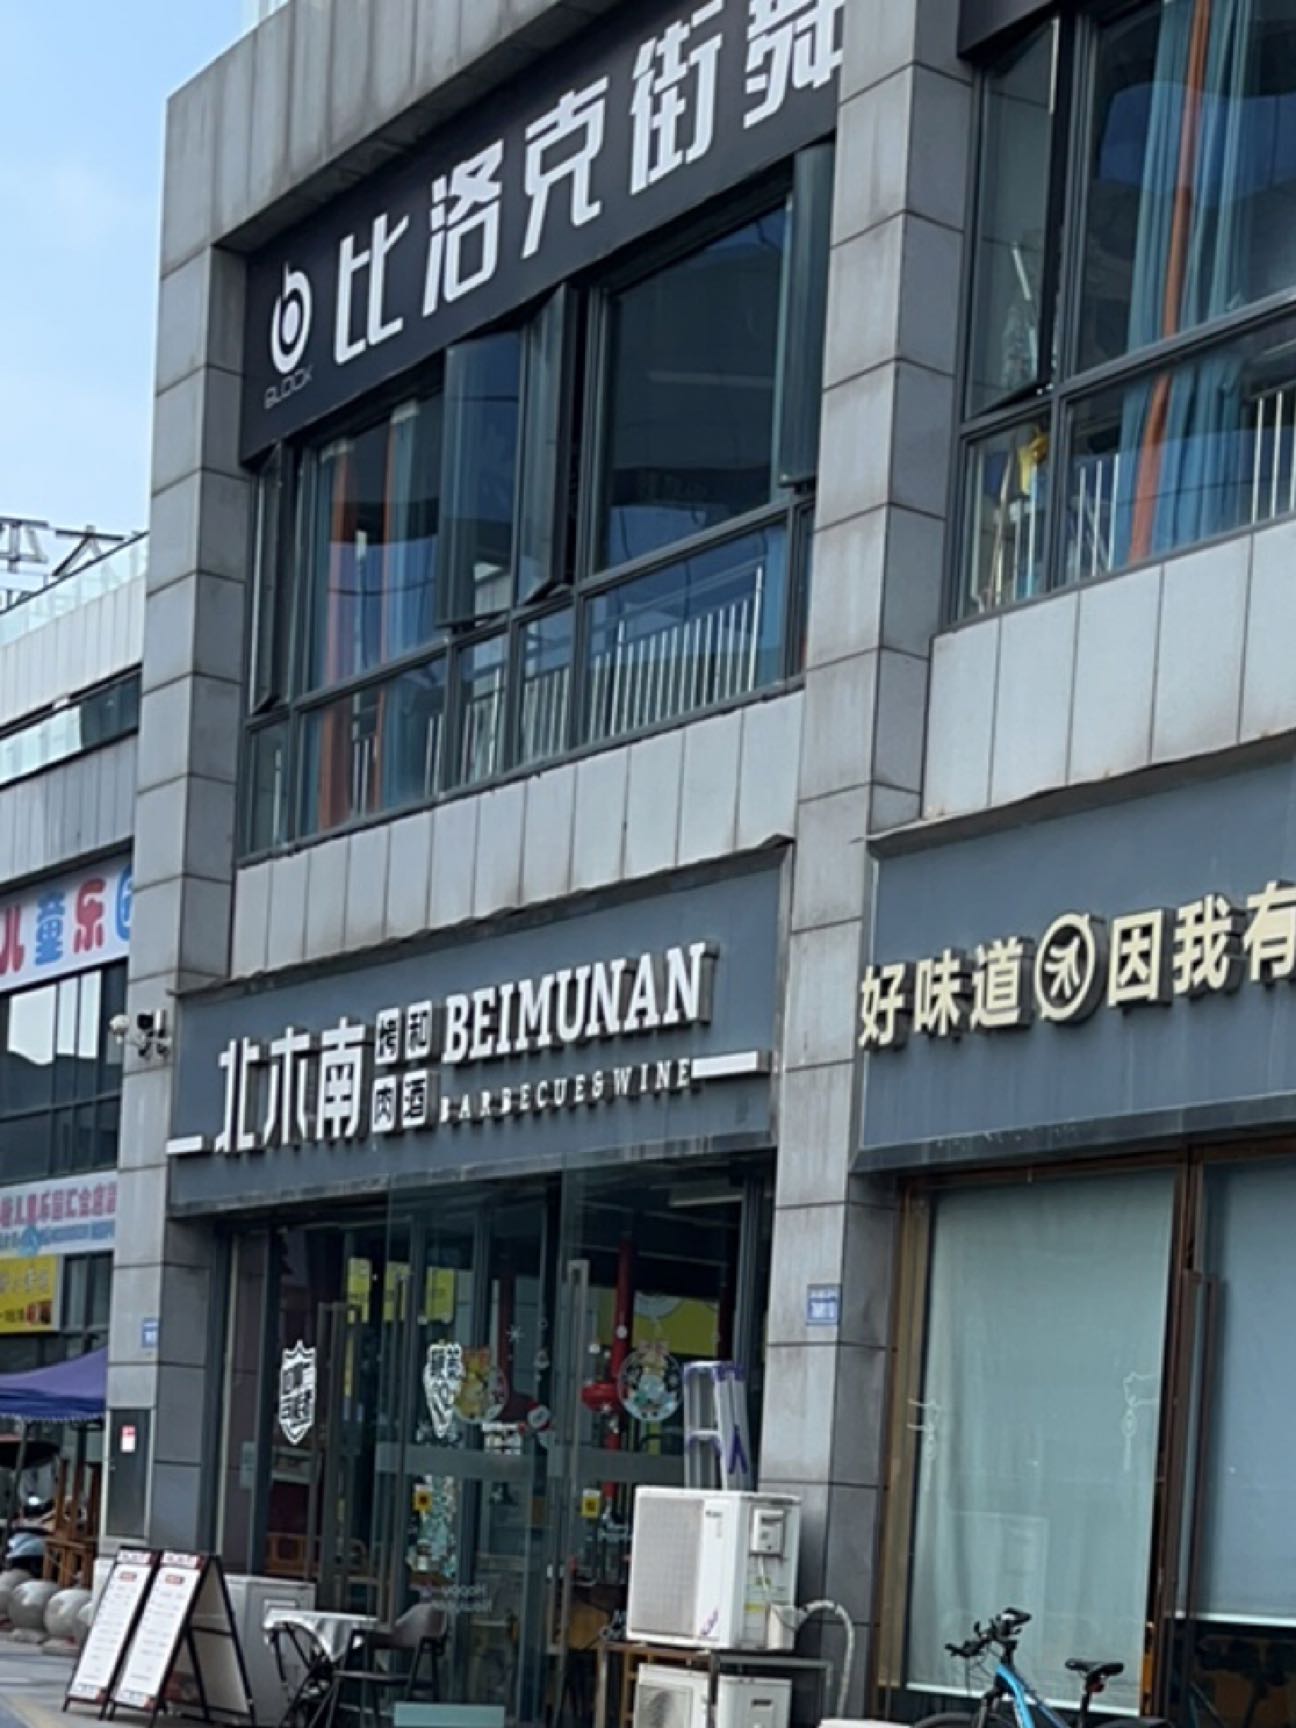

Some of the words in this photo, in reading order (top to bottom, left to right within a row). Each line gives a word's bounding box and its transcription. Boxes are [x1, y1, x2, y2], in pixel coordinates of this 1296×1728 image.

[441, 942, 716, 1064] BEIMUNAN
[857, 936, 1028, 1048] 好味道
[214, 1016, 368, 1154] 北木南
